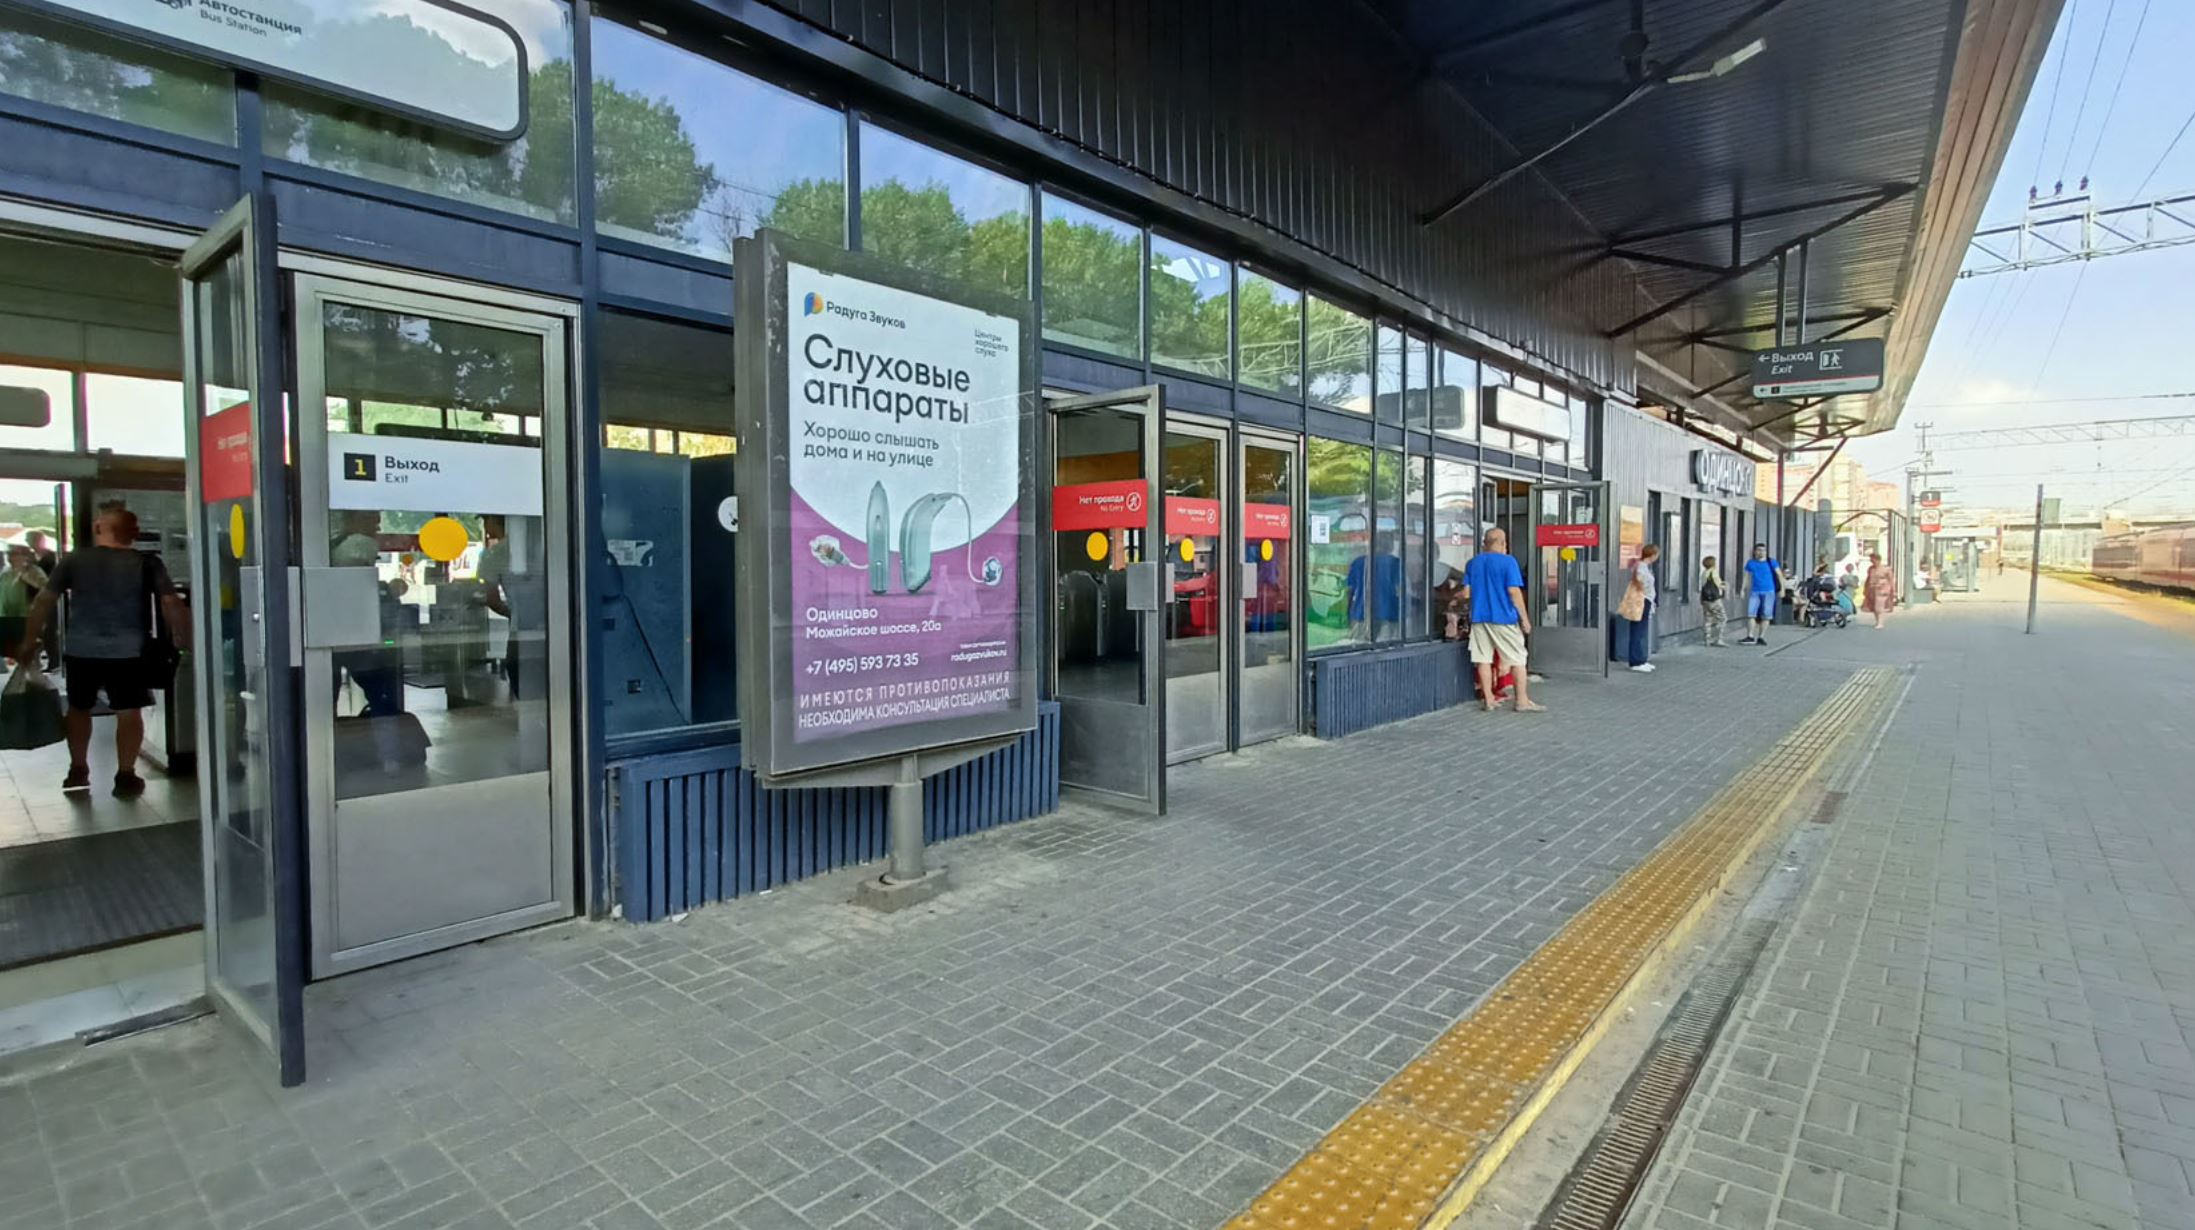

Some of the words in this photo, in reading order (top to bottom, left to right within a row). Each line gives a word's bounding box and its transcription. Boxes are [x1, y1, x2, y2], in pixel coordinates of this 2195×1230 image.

[200, 9, 222, 24] Bus
[226, 17, 268, 37] Station
[826, 301, 868, 320] Радуга
[869, 310, 906, 329] Звуков
[804, 333, 971, 393] Слуховые
[1771, 351, 1814, 363] Выход
[1771, 365, 1793, 375] Exit
[803, 378, 969, 424] аппараты
[804, 420, 871, 443] Хорошо
[874, 431, 940, 450] слышать
[354, 459, 367, 476] 1
[384, 455, 440, 473] Выход
[803, 443, 848, 459] дома
[852, 448, 863, 461] и
[866, 449, 886, 463] на
[889, 451, 934, 468] улице
[384, 472, 409, 484] Exit
[806, 607, 879, 623] Одинцово
[806, 625, 878, 640] Можайское
[880, 622, 920, 636] шоссе,
[922, 619, 942, 632] 20а
[805, 660, 823, 676] +7
[825, 656, 859, 677] (495)
[860, 655, 883, 671] 593
[885, 654, 901, 669] 73
[903, 652, 920, 667] 35
[800, 686, 873, 709] ИМЕЮТСЯ
[879, 671, 1010, 700] ПРОТИВОПОКАЗАНИЯ
[798, 705, 876, 728] НЕОБХОДИМА
[875, 695, 950, 719] КОНСУЛЬТАЦИЯ
[950, 687, 1011, 709] СПЕЦИАЛИСТА
